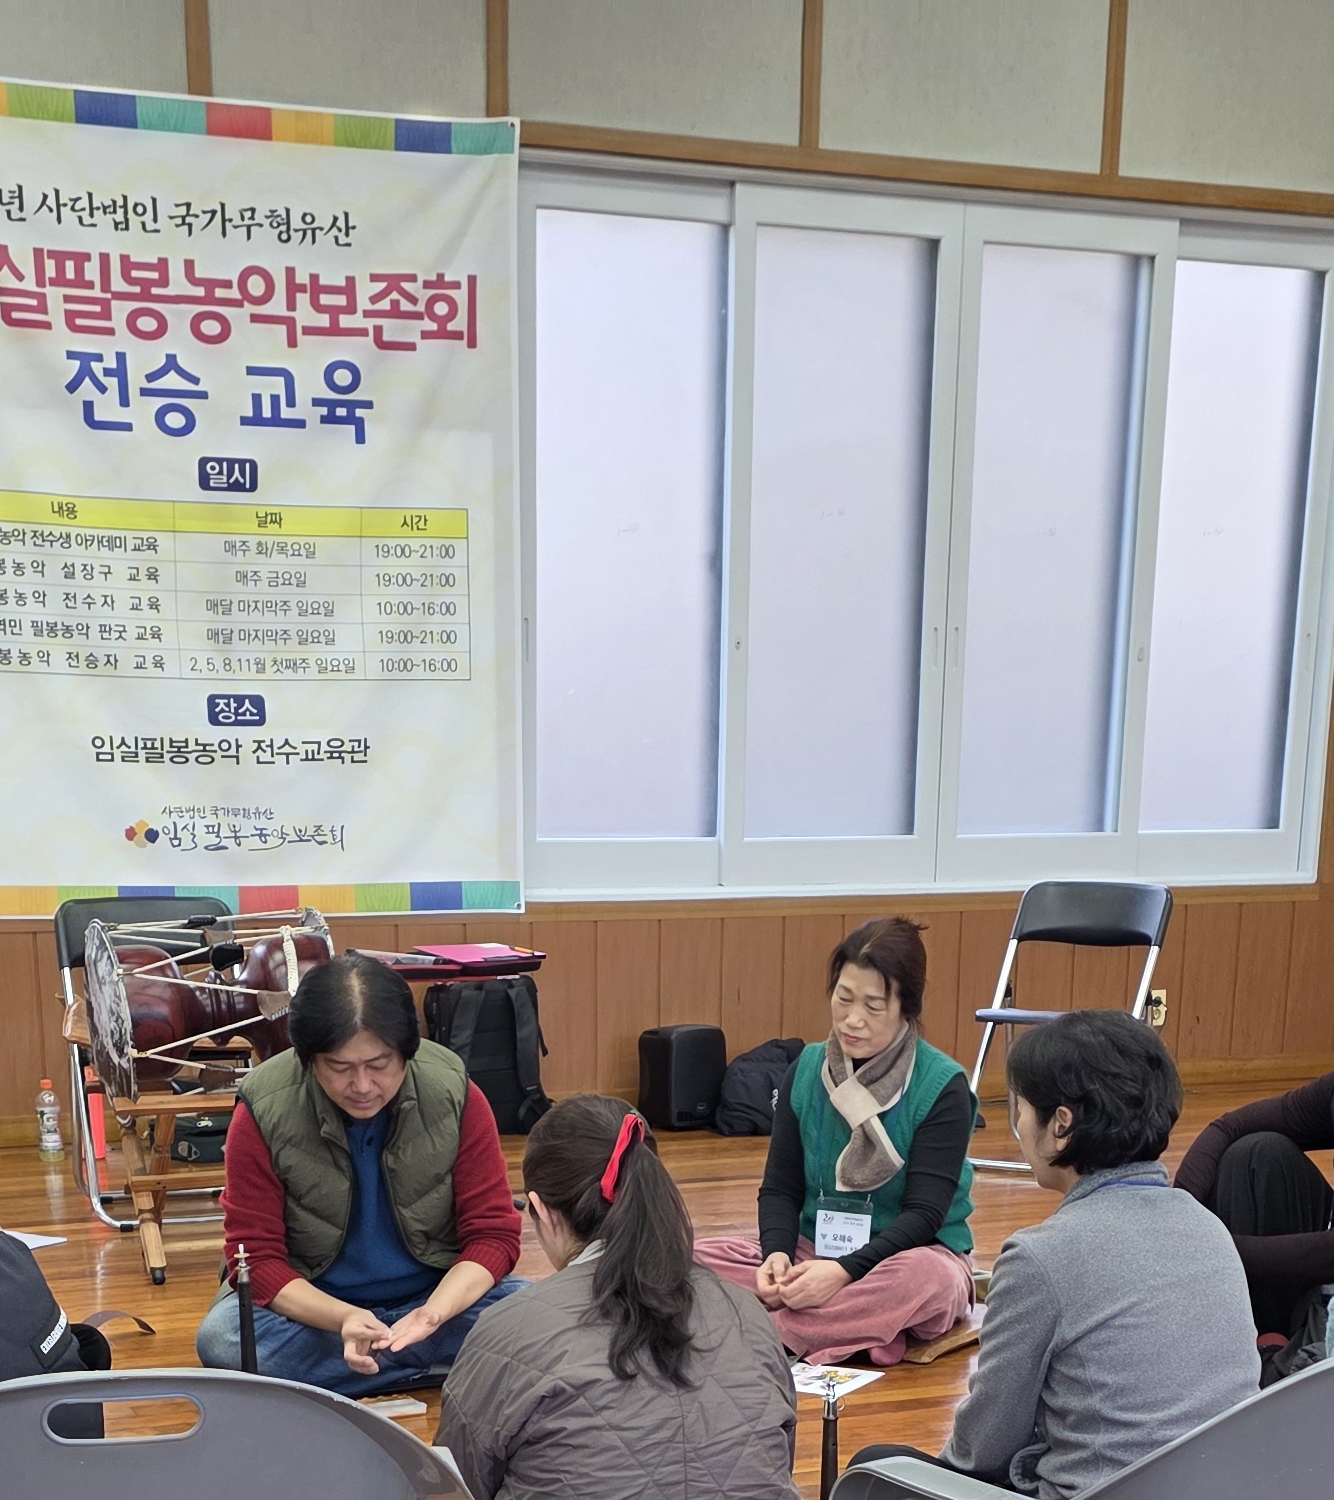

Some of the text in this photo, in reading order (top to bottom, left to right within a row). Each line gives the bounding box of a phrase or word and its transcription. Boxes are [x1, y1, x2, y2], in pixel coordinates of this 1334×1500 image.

[33, 186, 162, 236] 사단법인
[167, 200, 358, 249] 국가무형유산
[64, 349, 375, 445] 전승 교육
[205, 460, 253, 490] 일시
[51, 500, 79, 520] 내용
[255, 511, 283, 529] 날짜
[400, 514, 429, 531] 시간
[30, 529, 72, 549] 전수생
[75, 533, 127, 553] 아카데미
[131, 536, 159, 554] 교육
[223, 540, 317, 559] 매주 화/목요일
[374, 543, 456, 559] 19:00~21:00
[61, 562, 114, 581] 설장구
[126, 566, 160, 584] 교육
[235, 570, 308, 588] 매주 금요일
[375, 572, 456, 588] 19:00~21:00
[62, 592, 116, 611] 전수자
[129, 596, 161, 614] 교육
[205, 599, 336, 617] 매달 마지막주 일요일
[376, 600, 457, 617] 10:00~16:00
[30, 619, 91, 640] 필봉농악
[98, 623, 128, 641] 판굿
[134, 625, 164, 643] 교육
[206, 627, 336, 646] 매달 마지막주 일요일
[377, 629, 458, 645] 19:00~21:00
[65, 651, 119, 671] 전승자
[132, 654, 166, 672] 교육
[270, 657, 312, 675] 첫째주
[315, 656, 356, 674] 일요일
[378, 657, 458, 673] 10:00~16:00
[214, 697, 261, 723] 장소
[90, 734, 371, 767] 임실필봉농악 전수교육관
[161, 805, 208, 821] 사단법인
